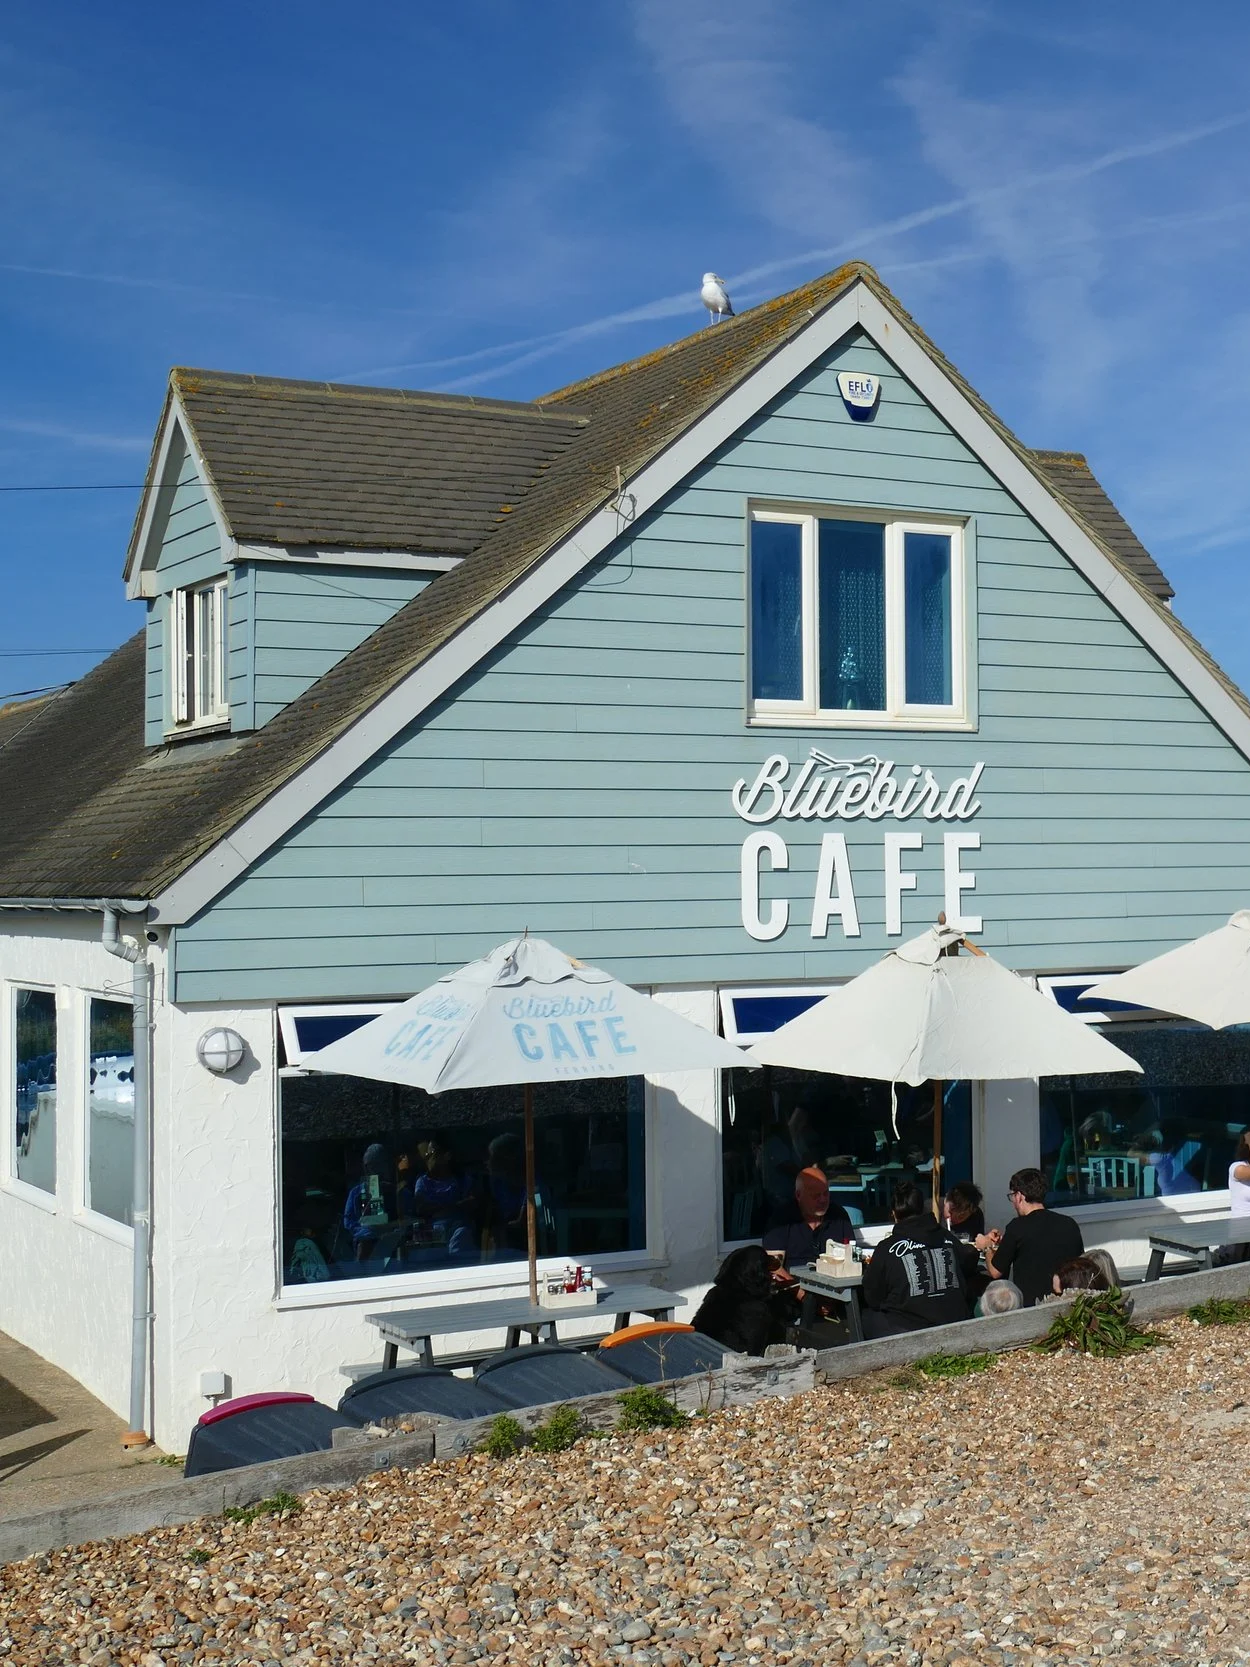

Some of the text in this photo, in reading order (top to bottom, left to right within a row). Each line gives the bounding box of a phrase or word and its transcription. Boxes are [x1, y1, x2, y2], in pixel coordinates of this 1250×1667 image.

[848, 380, 867, 393] EFL
[732, 753, 986, 823] Bluebird
[740, 830, 983, 941] CAFE
[503, 989, 617, 1019] Bluebird
[511, 1015, 637, 1062] CAFE
